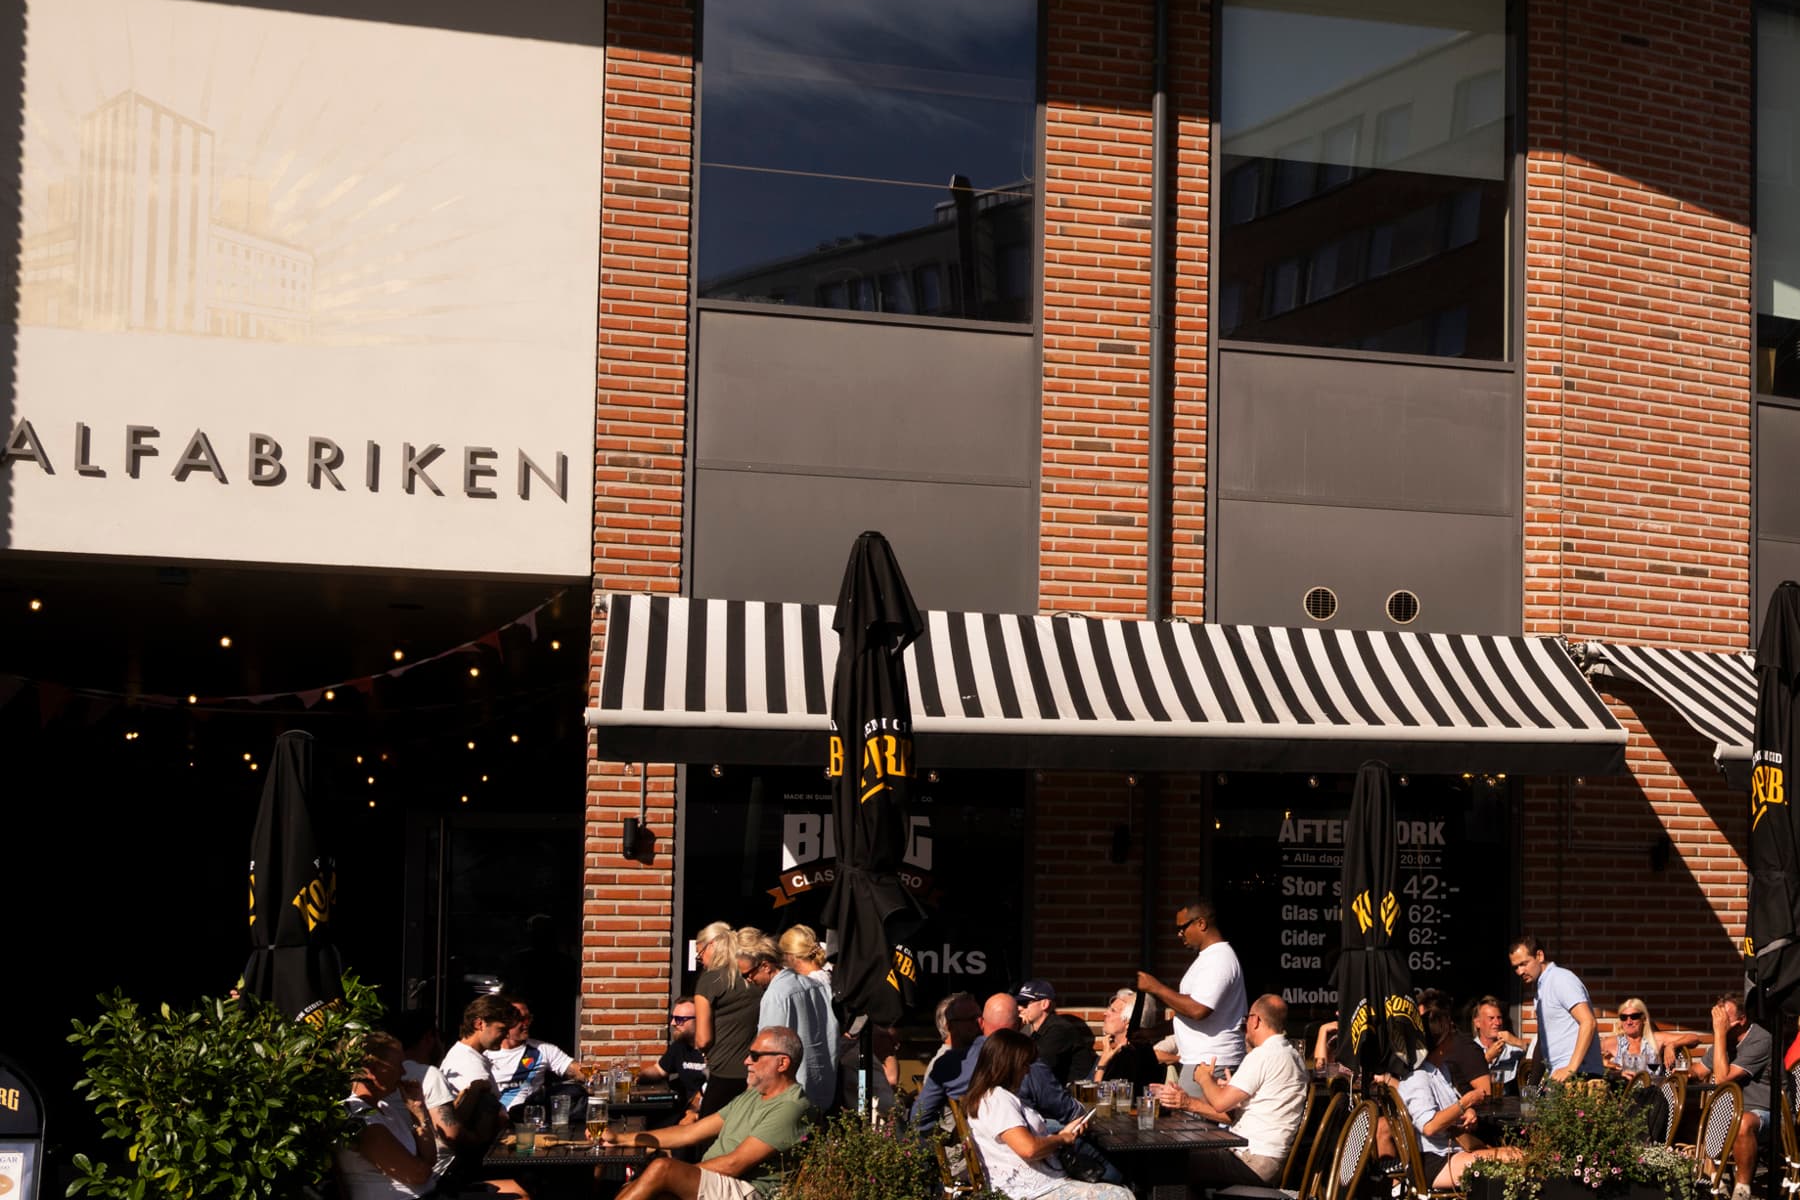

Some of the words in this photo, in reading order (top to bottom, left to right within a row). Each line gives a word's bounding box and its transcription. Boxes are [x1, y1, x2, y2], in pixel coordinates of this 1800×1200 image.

[0, 417, 568, 503] ALFABRIKEN
[782, 813, 933, 871] BG
[1278, 819, 1446, 846] AFTEORK
[1294, 853, 1316, 864] Alla
[1282, 875, 1327, 897] Stor
[1403, 874, 1460, 900] 42:-
[1281, 904, 1318, 921] Glas
[1408, 904, 1451, 923] 62:-
[1281, 928, 1327, 946] Cider
[1408, 928, 1447, 945] 62:-
[1280, 952, 1322, 969] Cava
[1408, 951, 1451, 970] 65:-
